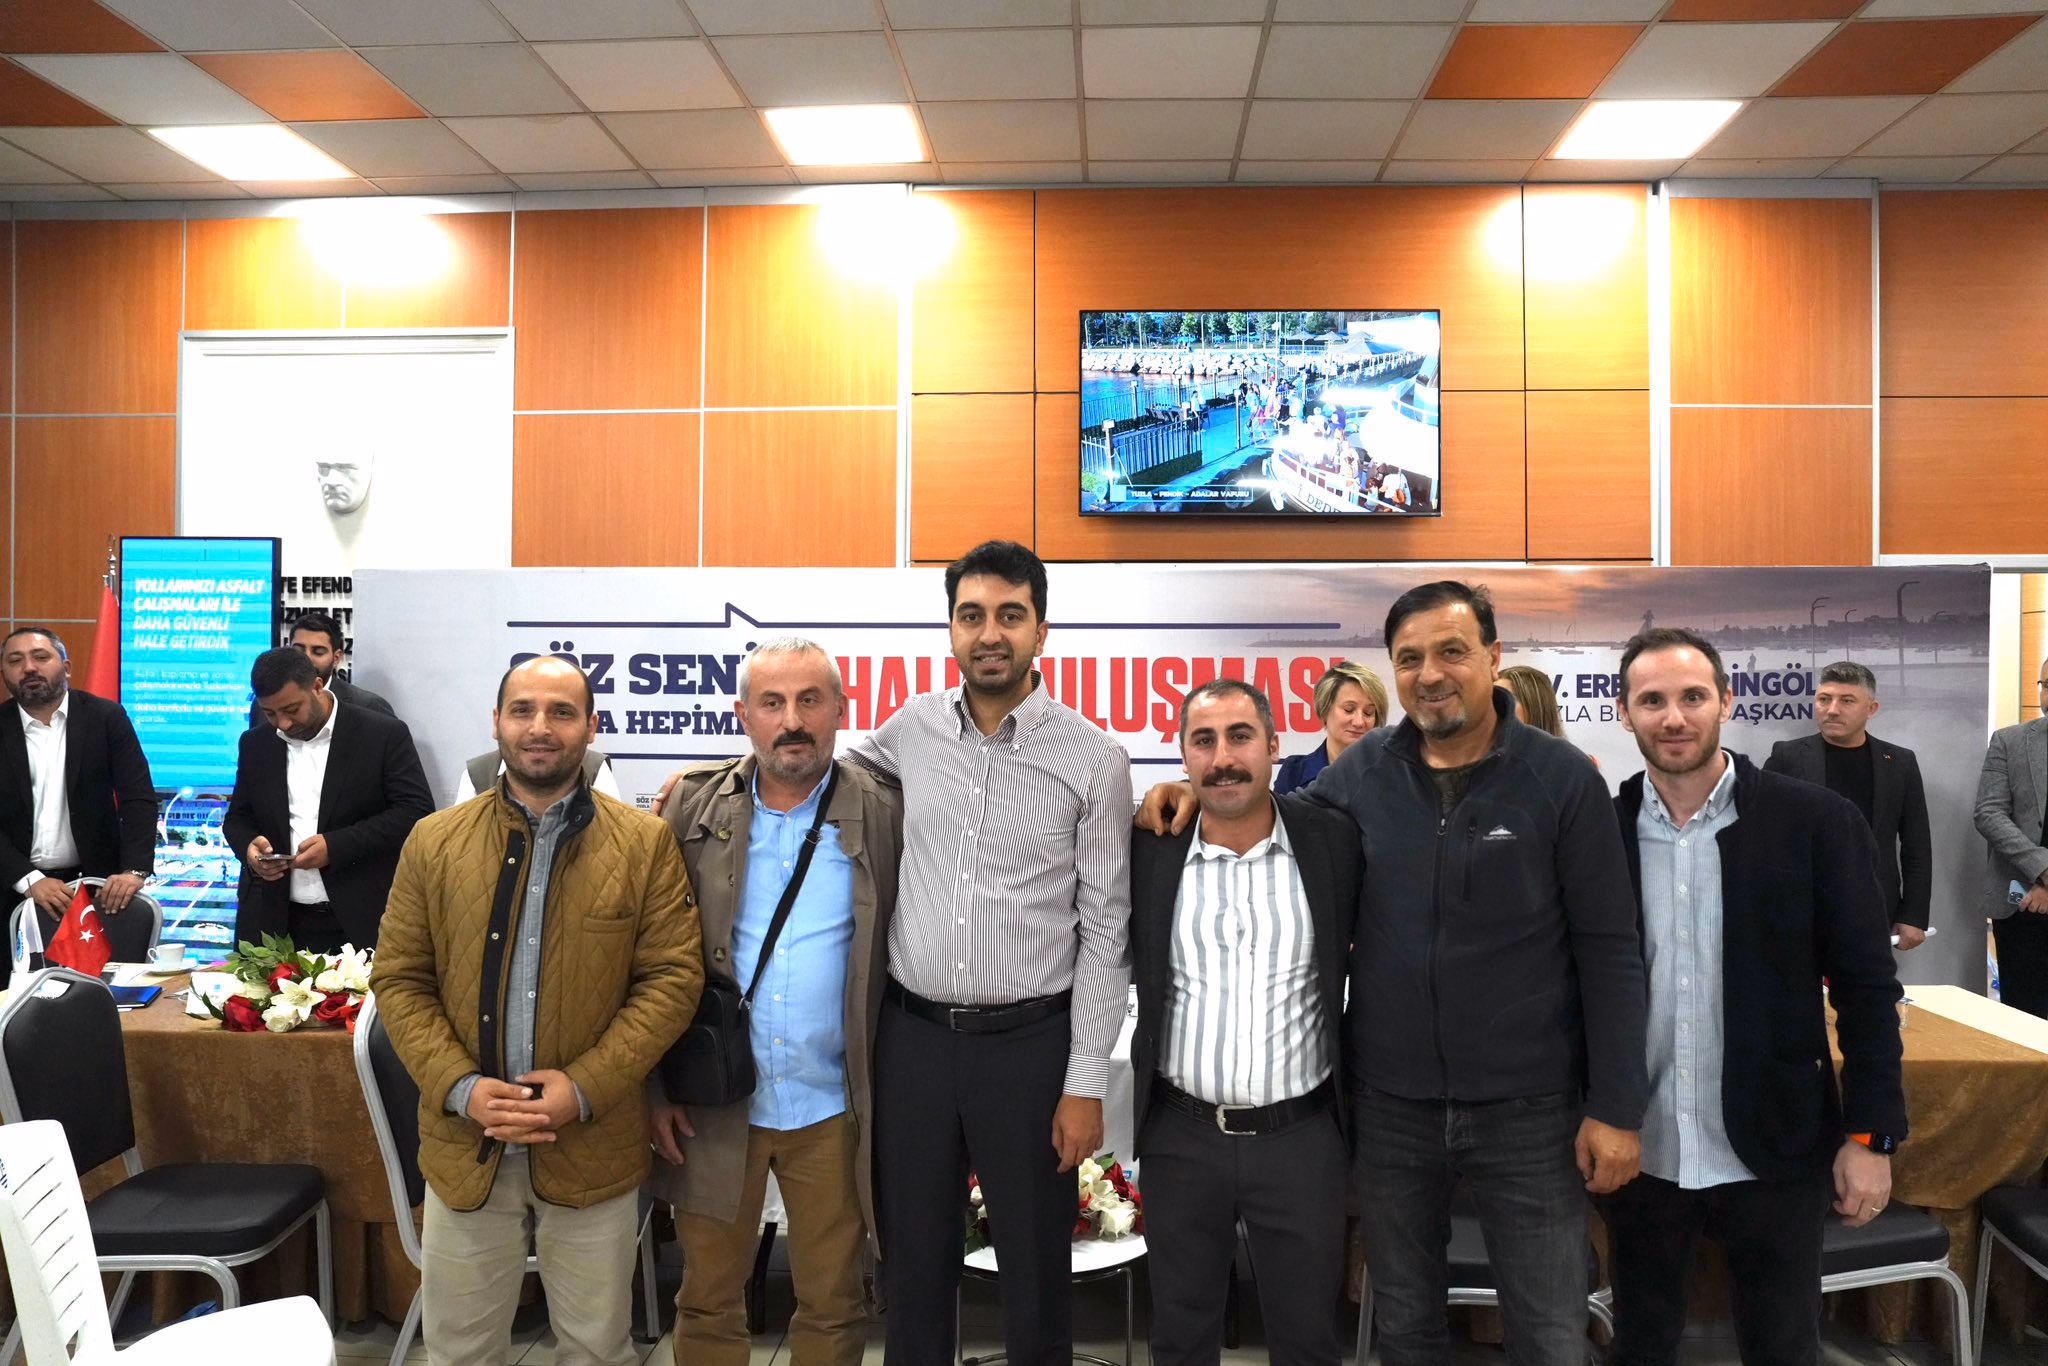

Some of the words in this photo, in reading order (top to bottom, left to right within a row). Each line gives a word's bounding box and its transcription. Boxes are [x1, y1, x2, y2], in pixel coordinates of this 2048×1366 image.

[216, 579, 265, 593] ASFALT
[302, 576, 352, 593] EFEND
[133, 615, 170, 630] DAHA
[173, 613, 230, 630] GÜVENLİ
[133, 634, 169, 648] HALE
[1723, 662, 1817, 697] İNGÖL
[1031, 656, 1345, 743] ULUŞAS
[1727, 703, 1813, 726] AŞKAN
